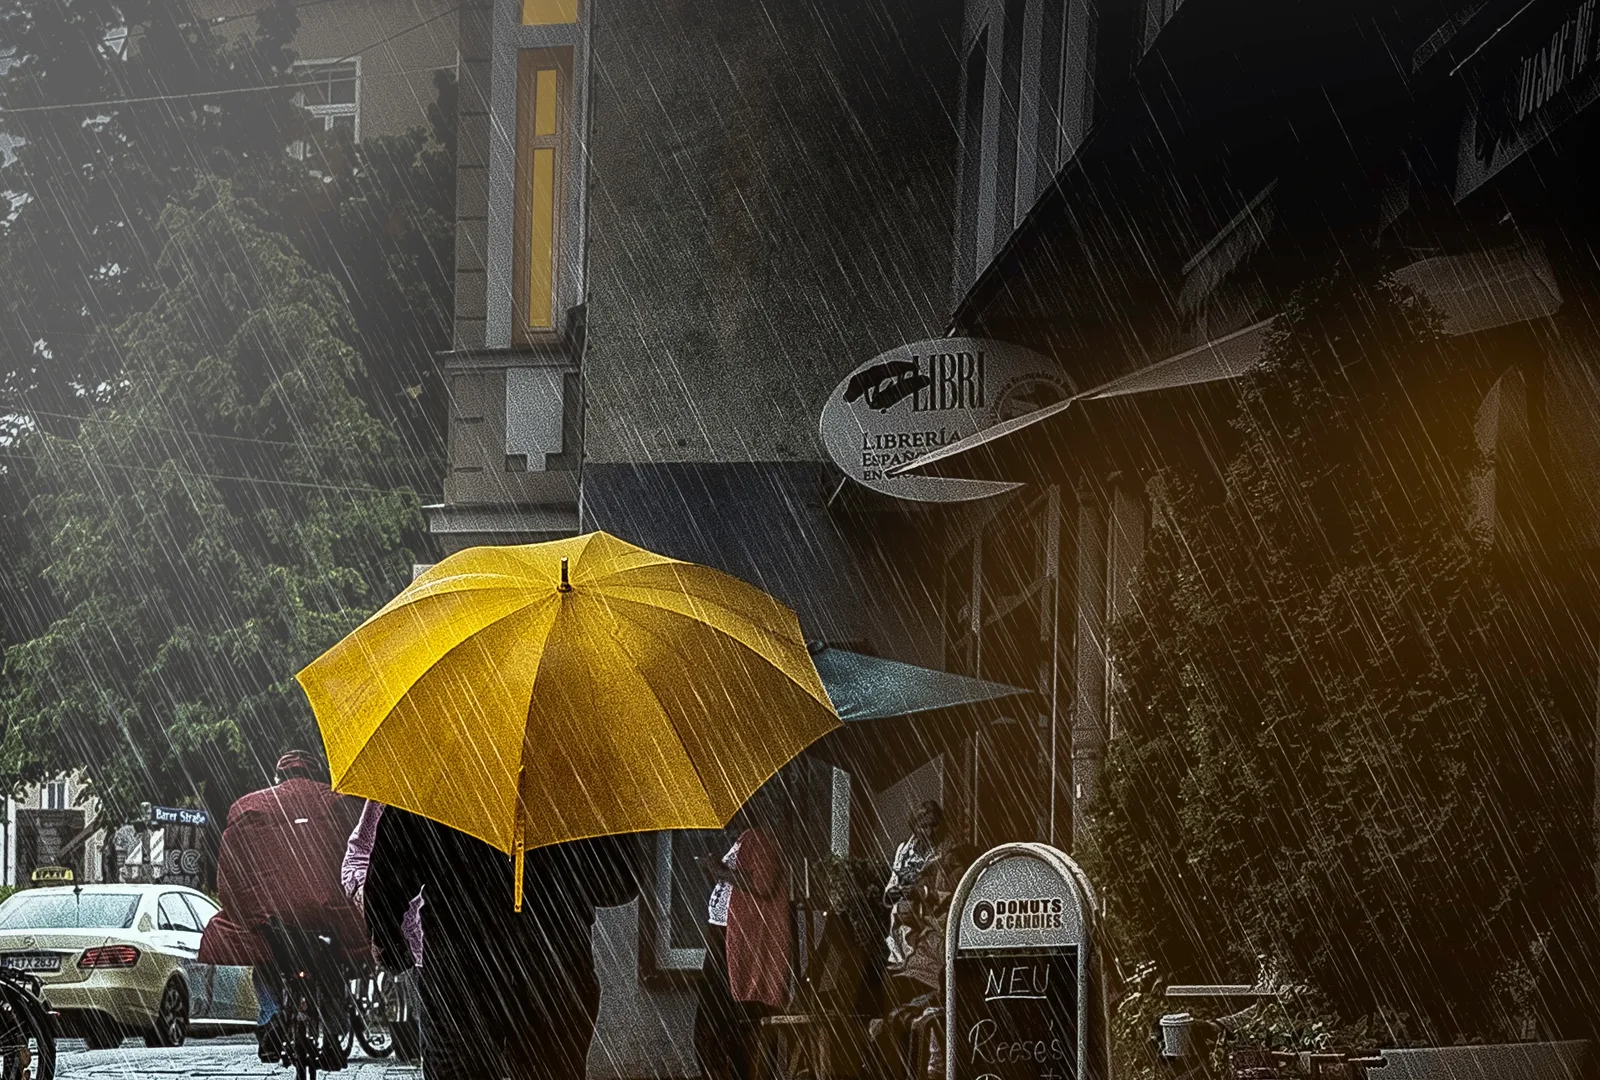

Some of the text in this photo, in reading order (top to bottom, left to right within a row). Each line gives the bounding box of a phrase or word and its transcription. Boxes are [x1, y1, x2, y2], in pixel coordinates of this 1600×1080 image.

[863, 427, 961, 450] LIBRERÍA
[155, 808, 206, 825] Barer Straße
[996, 899, 1062, 915] DONUTS
[1006, 914, 1061, 929] CANDIES
[984, 963, 1050, 996] NEU
[968, 1018, 1063, 1065] Reese's
